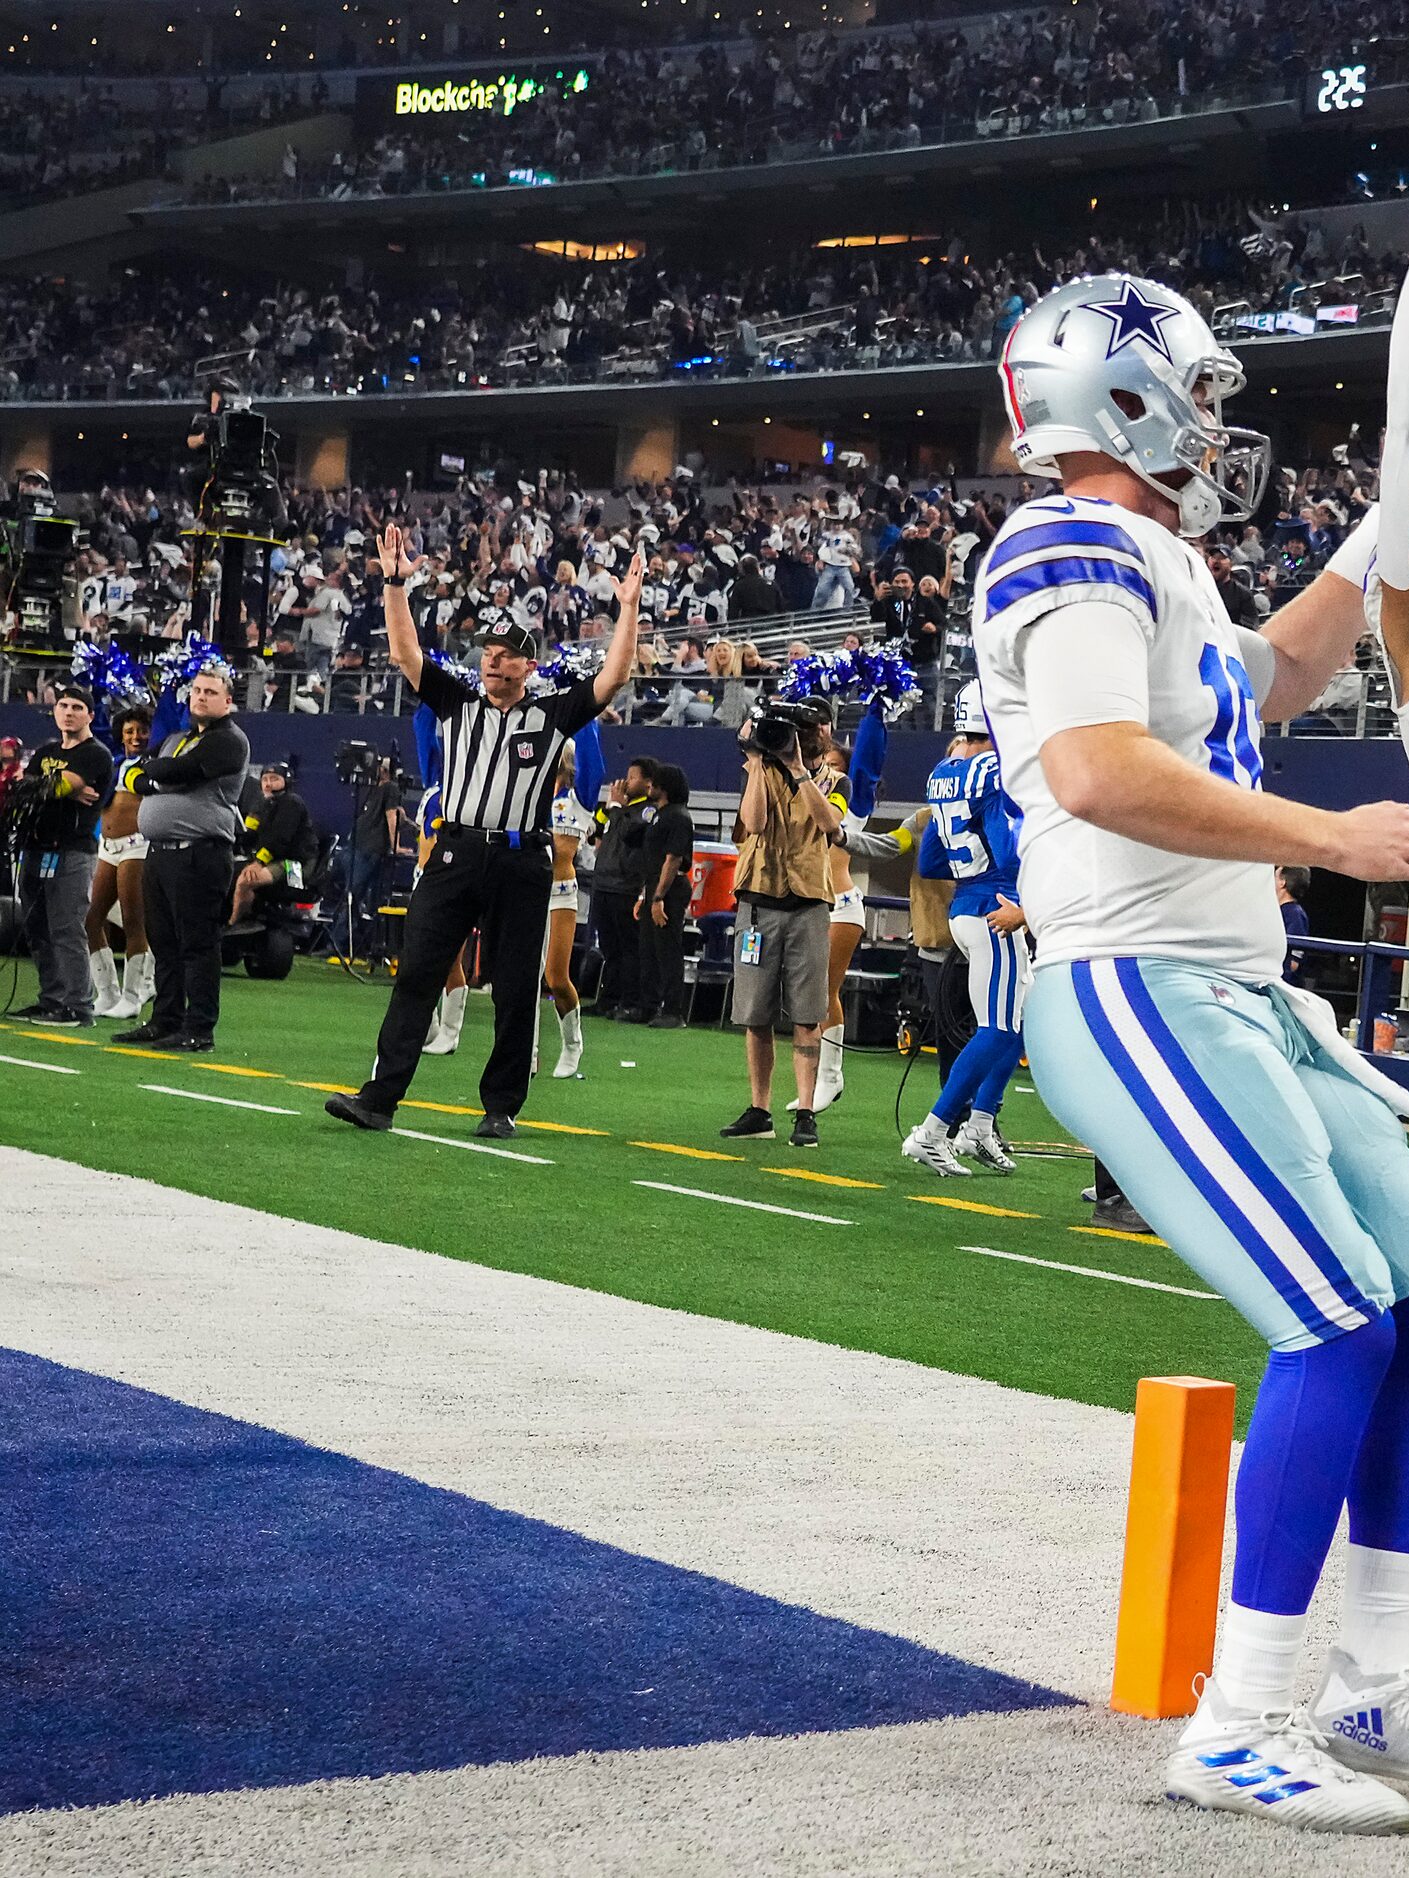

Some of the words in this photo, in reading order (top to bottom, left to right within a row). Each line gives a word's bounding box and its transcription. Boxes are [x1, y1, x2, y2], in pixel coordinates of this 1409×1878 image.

[1318, 65, 1366, 112] 2:25
[929, 777, 954, 800] THOMAS
[1332, 1720, 1388, 1752] adidas
